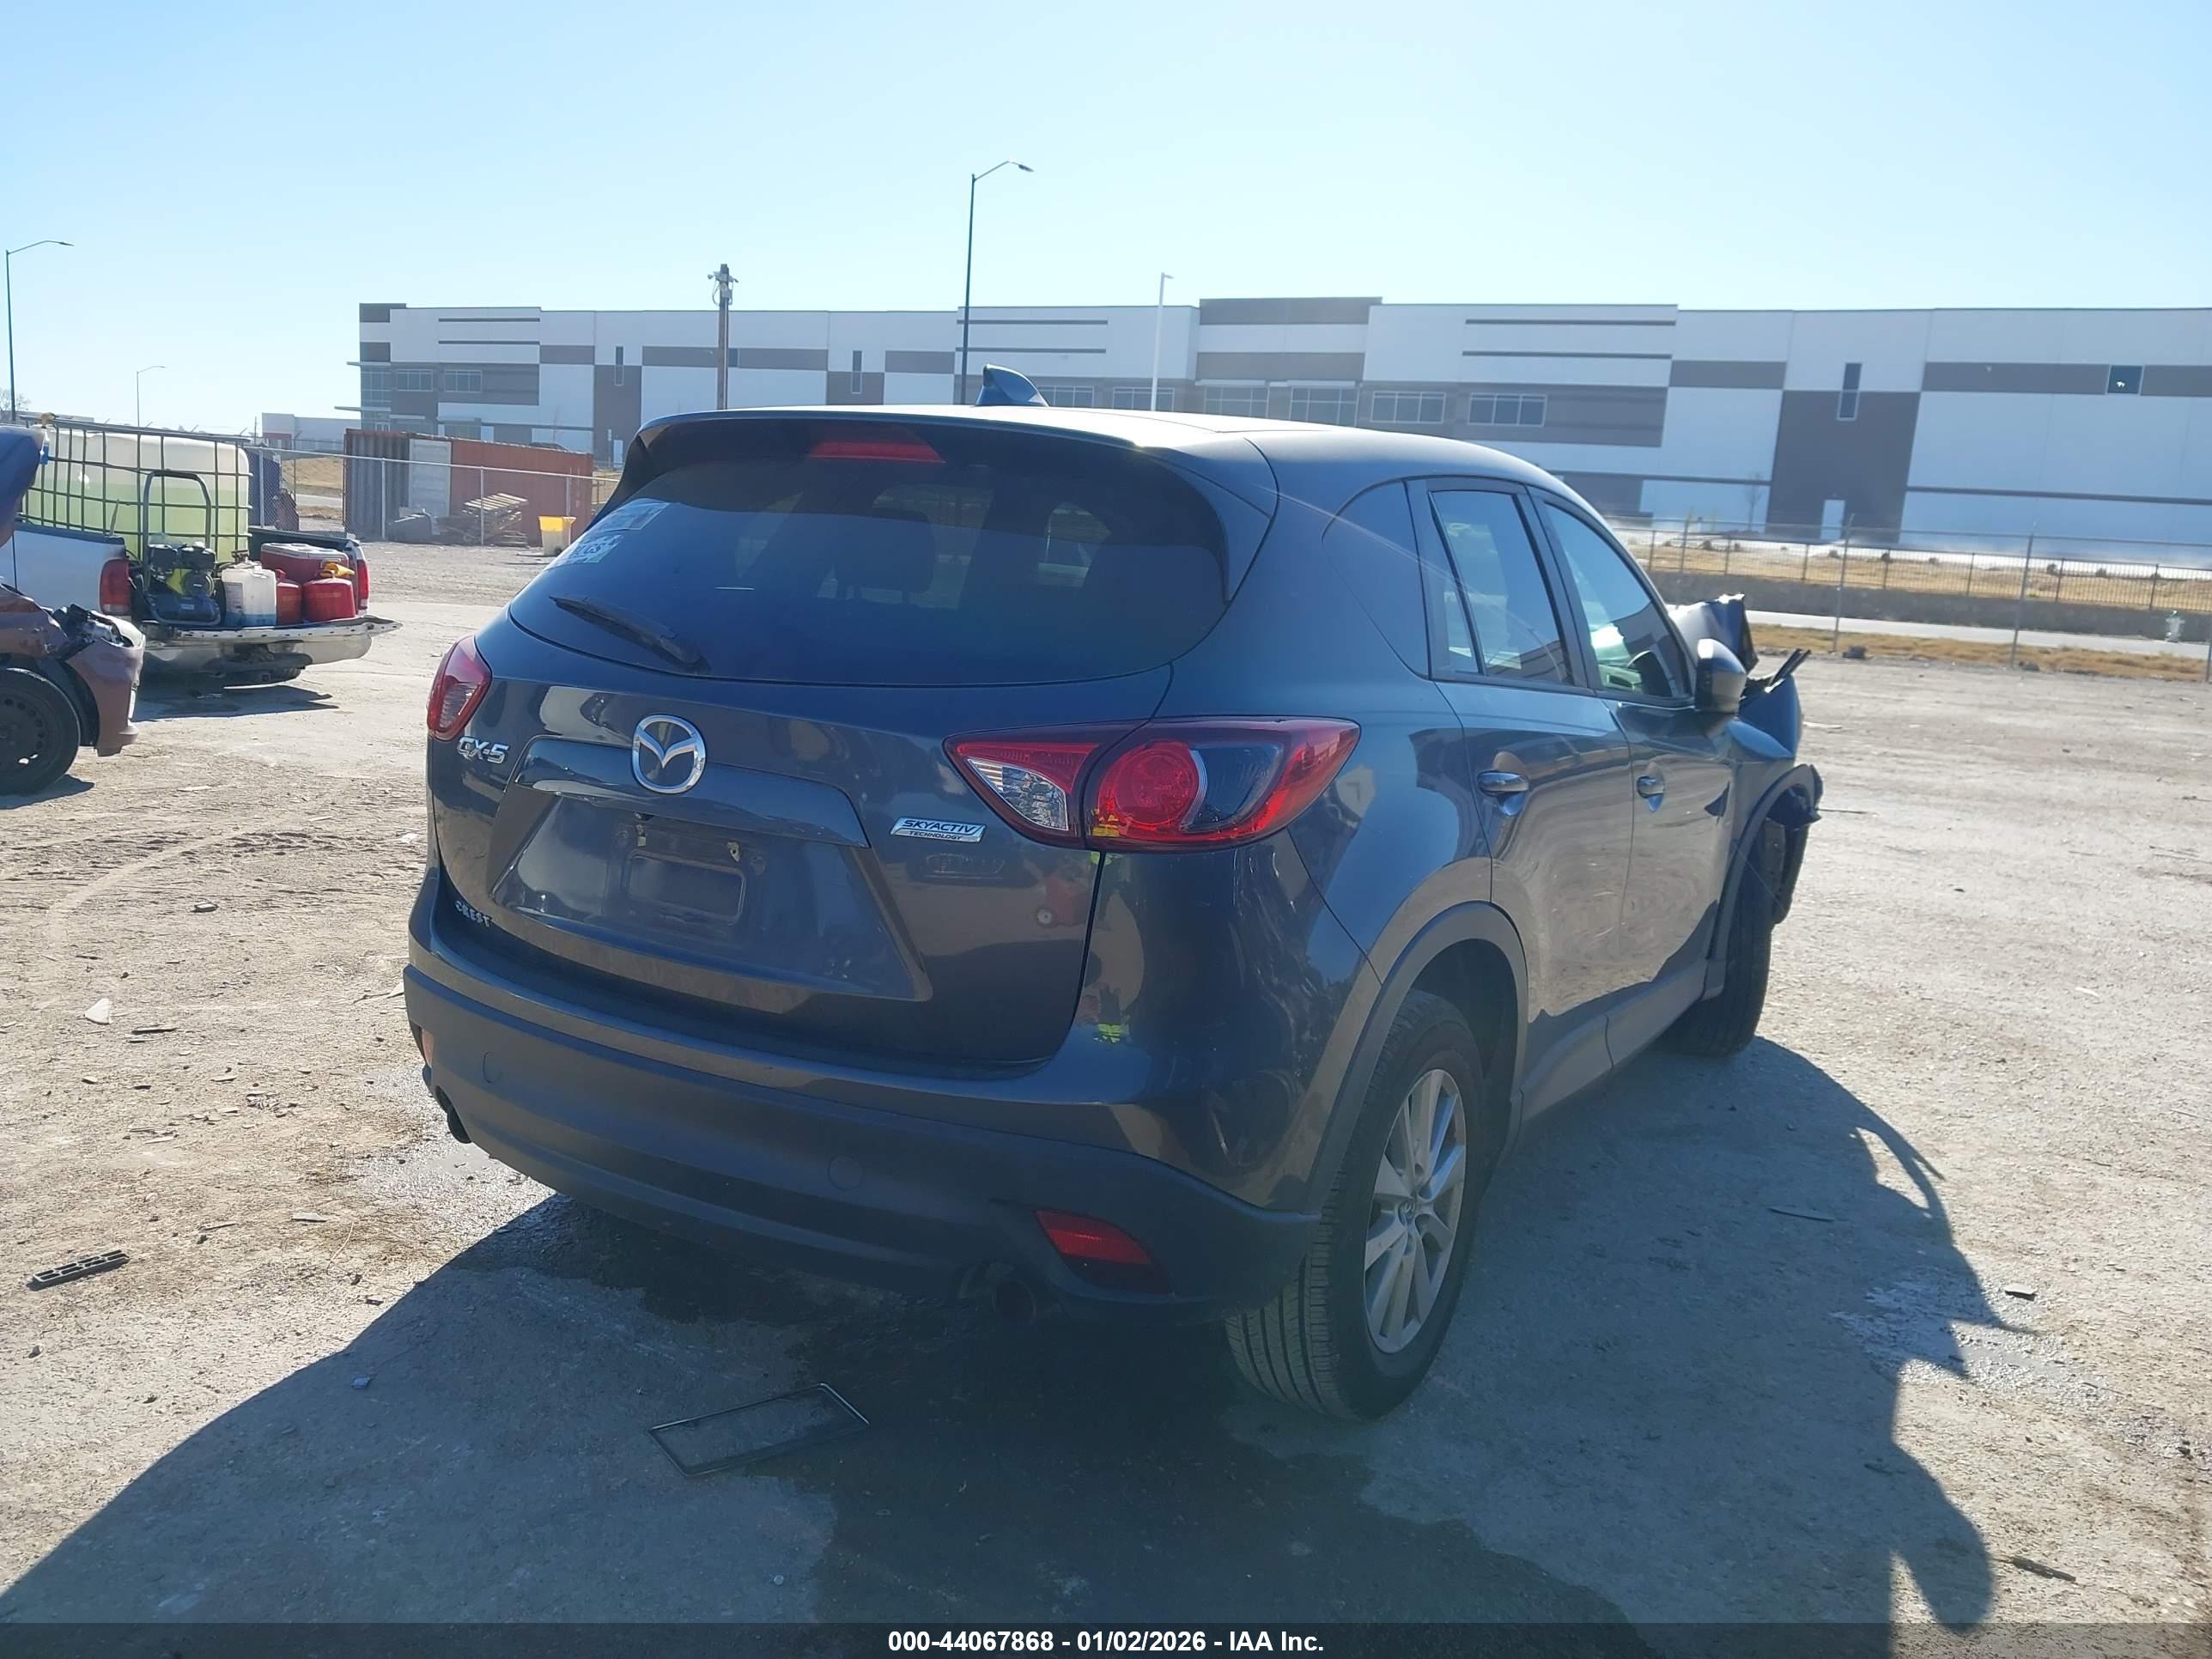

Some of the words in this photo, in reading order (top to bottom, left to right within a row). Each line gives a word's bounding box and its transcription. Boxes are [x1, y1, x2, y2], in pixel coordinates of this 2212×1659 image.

[457, 736, 509, 764] CX-5
[902, 819, 976, 833] SKYACTIV
[909, 830, 963, 840] TECHNOLOGY
